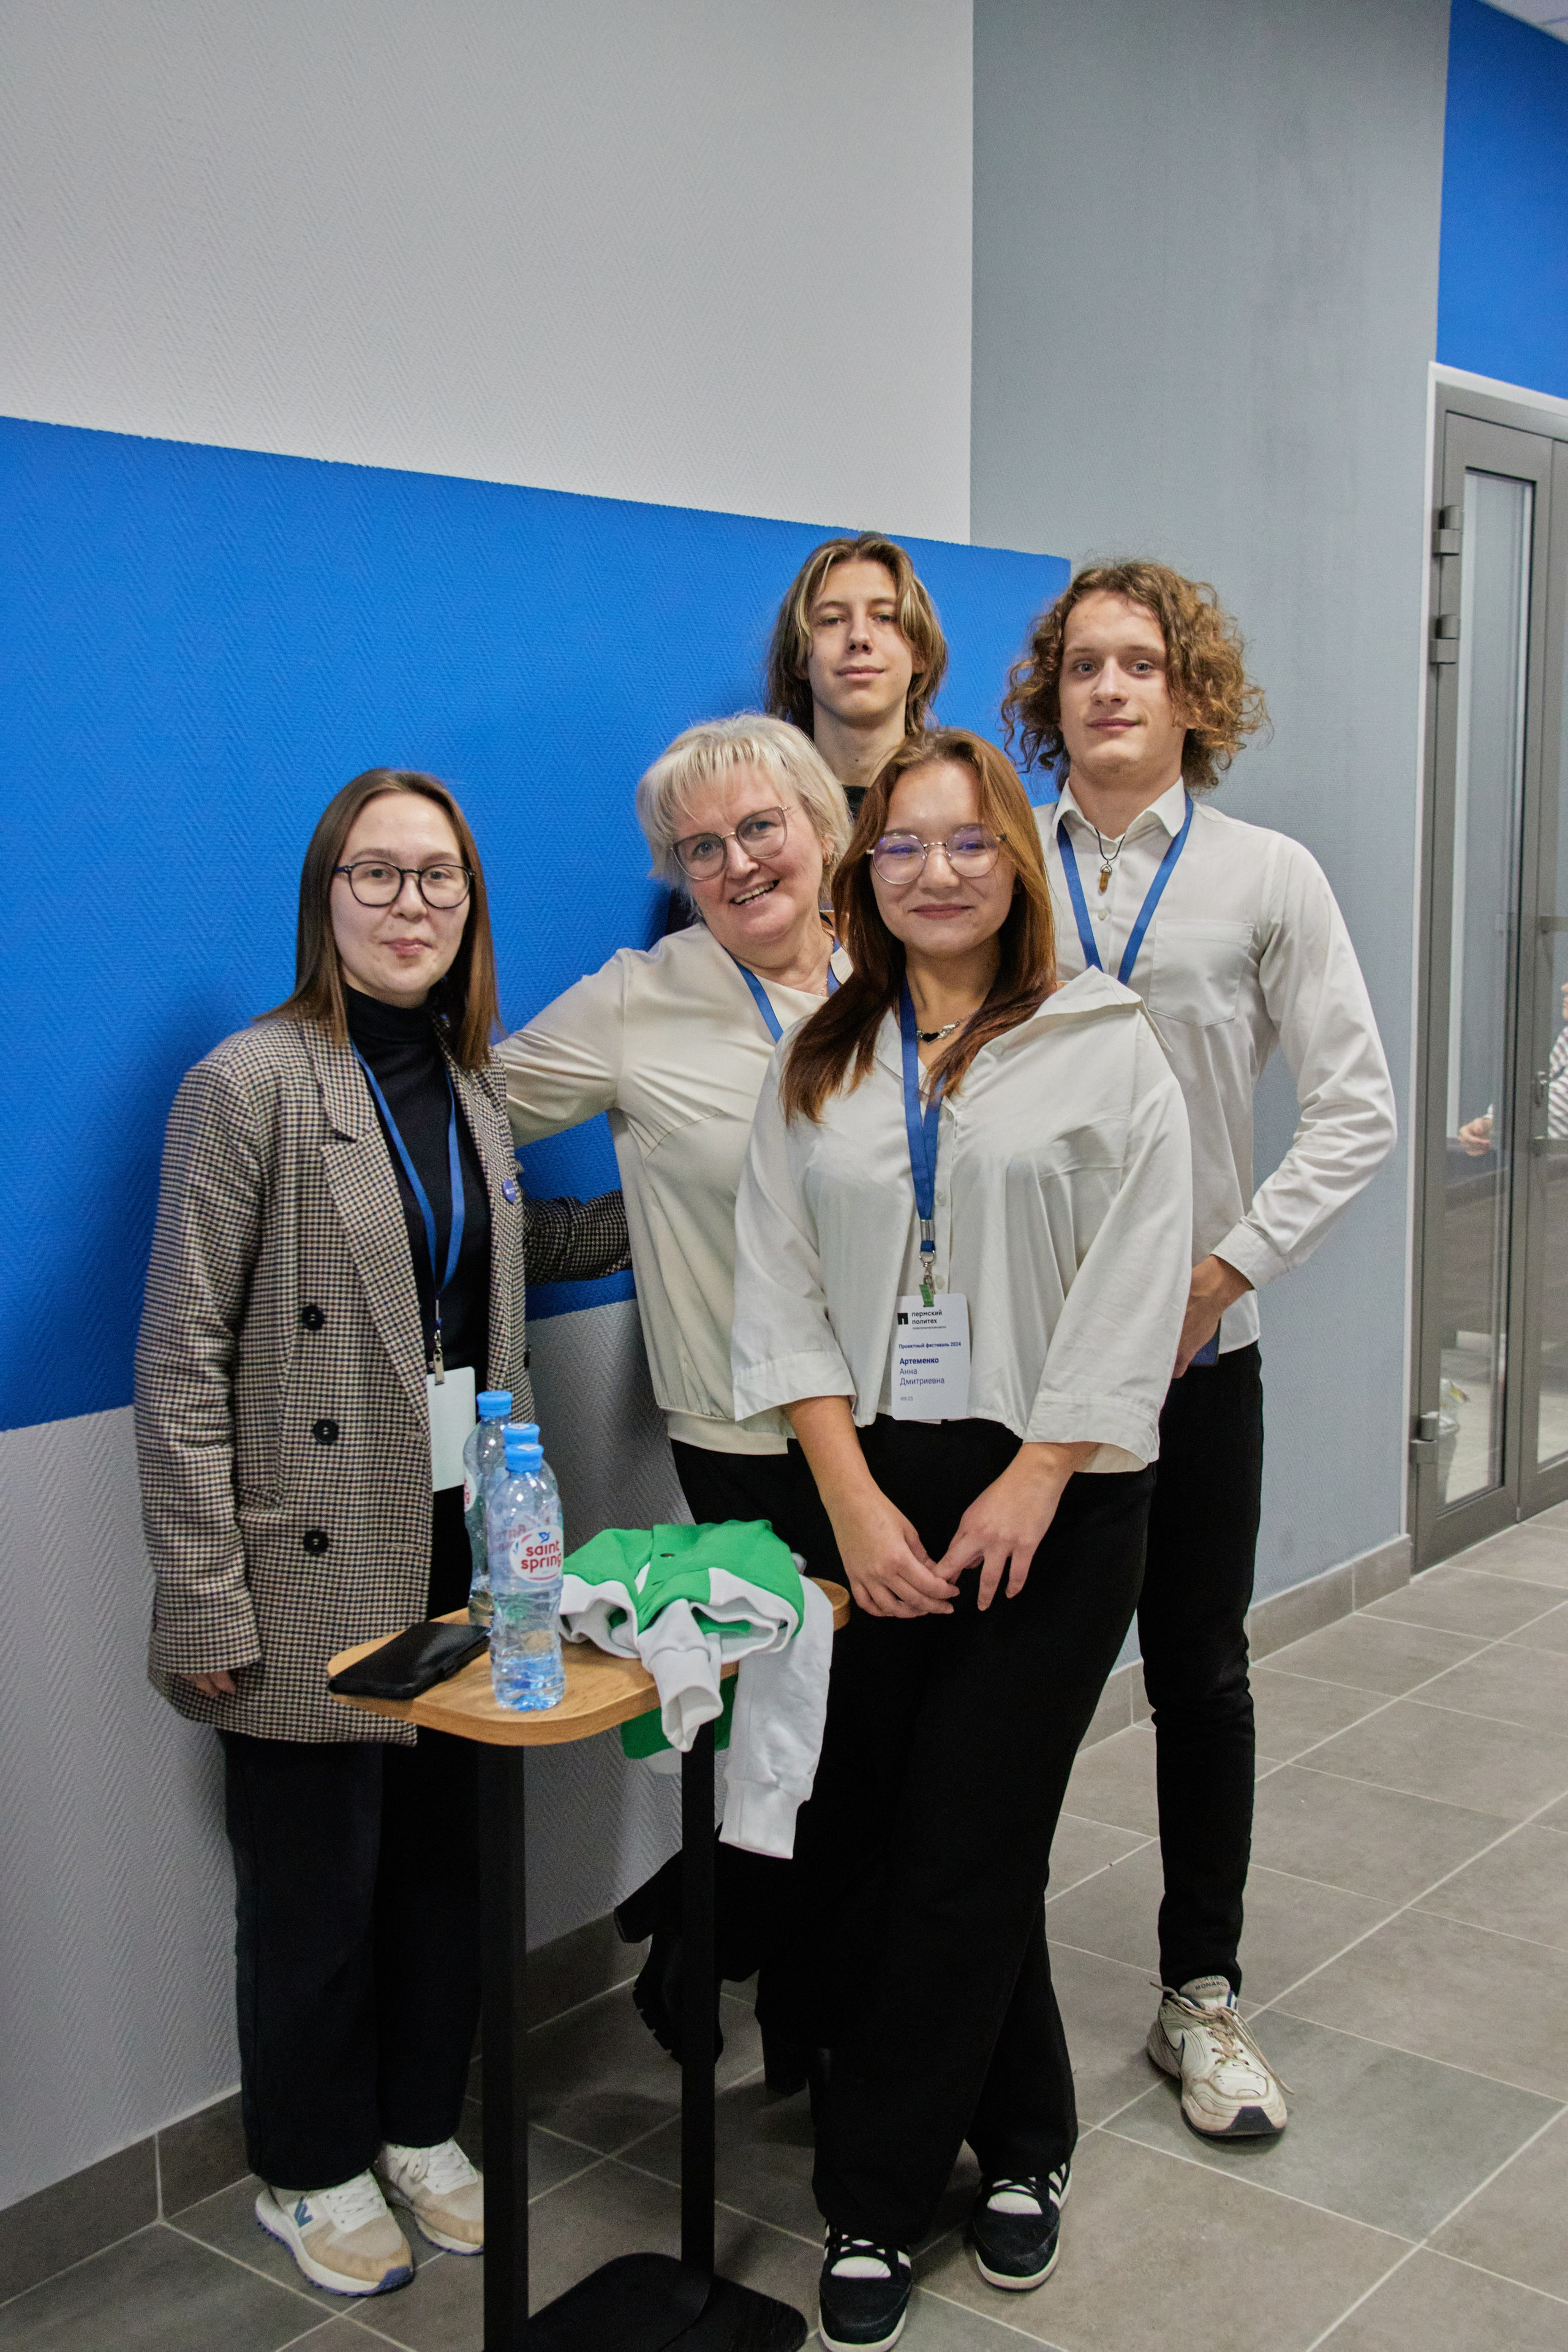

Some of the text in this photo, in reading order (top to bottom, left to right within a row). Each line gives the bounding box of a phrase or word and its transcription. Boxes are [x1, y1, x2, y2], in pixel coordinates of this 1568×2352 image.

[911, 1310, 943, 1318] пермский
[899, 1357, 940, 1366] Артеменко
[900, 1378, 945, 1386] Дмитриевна
[526, 1540, 560, 1557] saint
